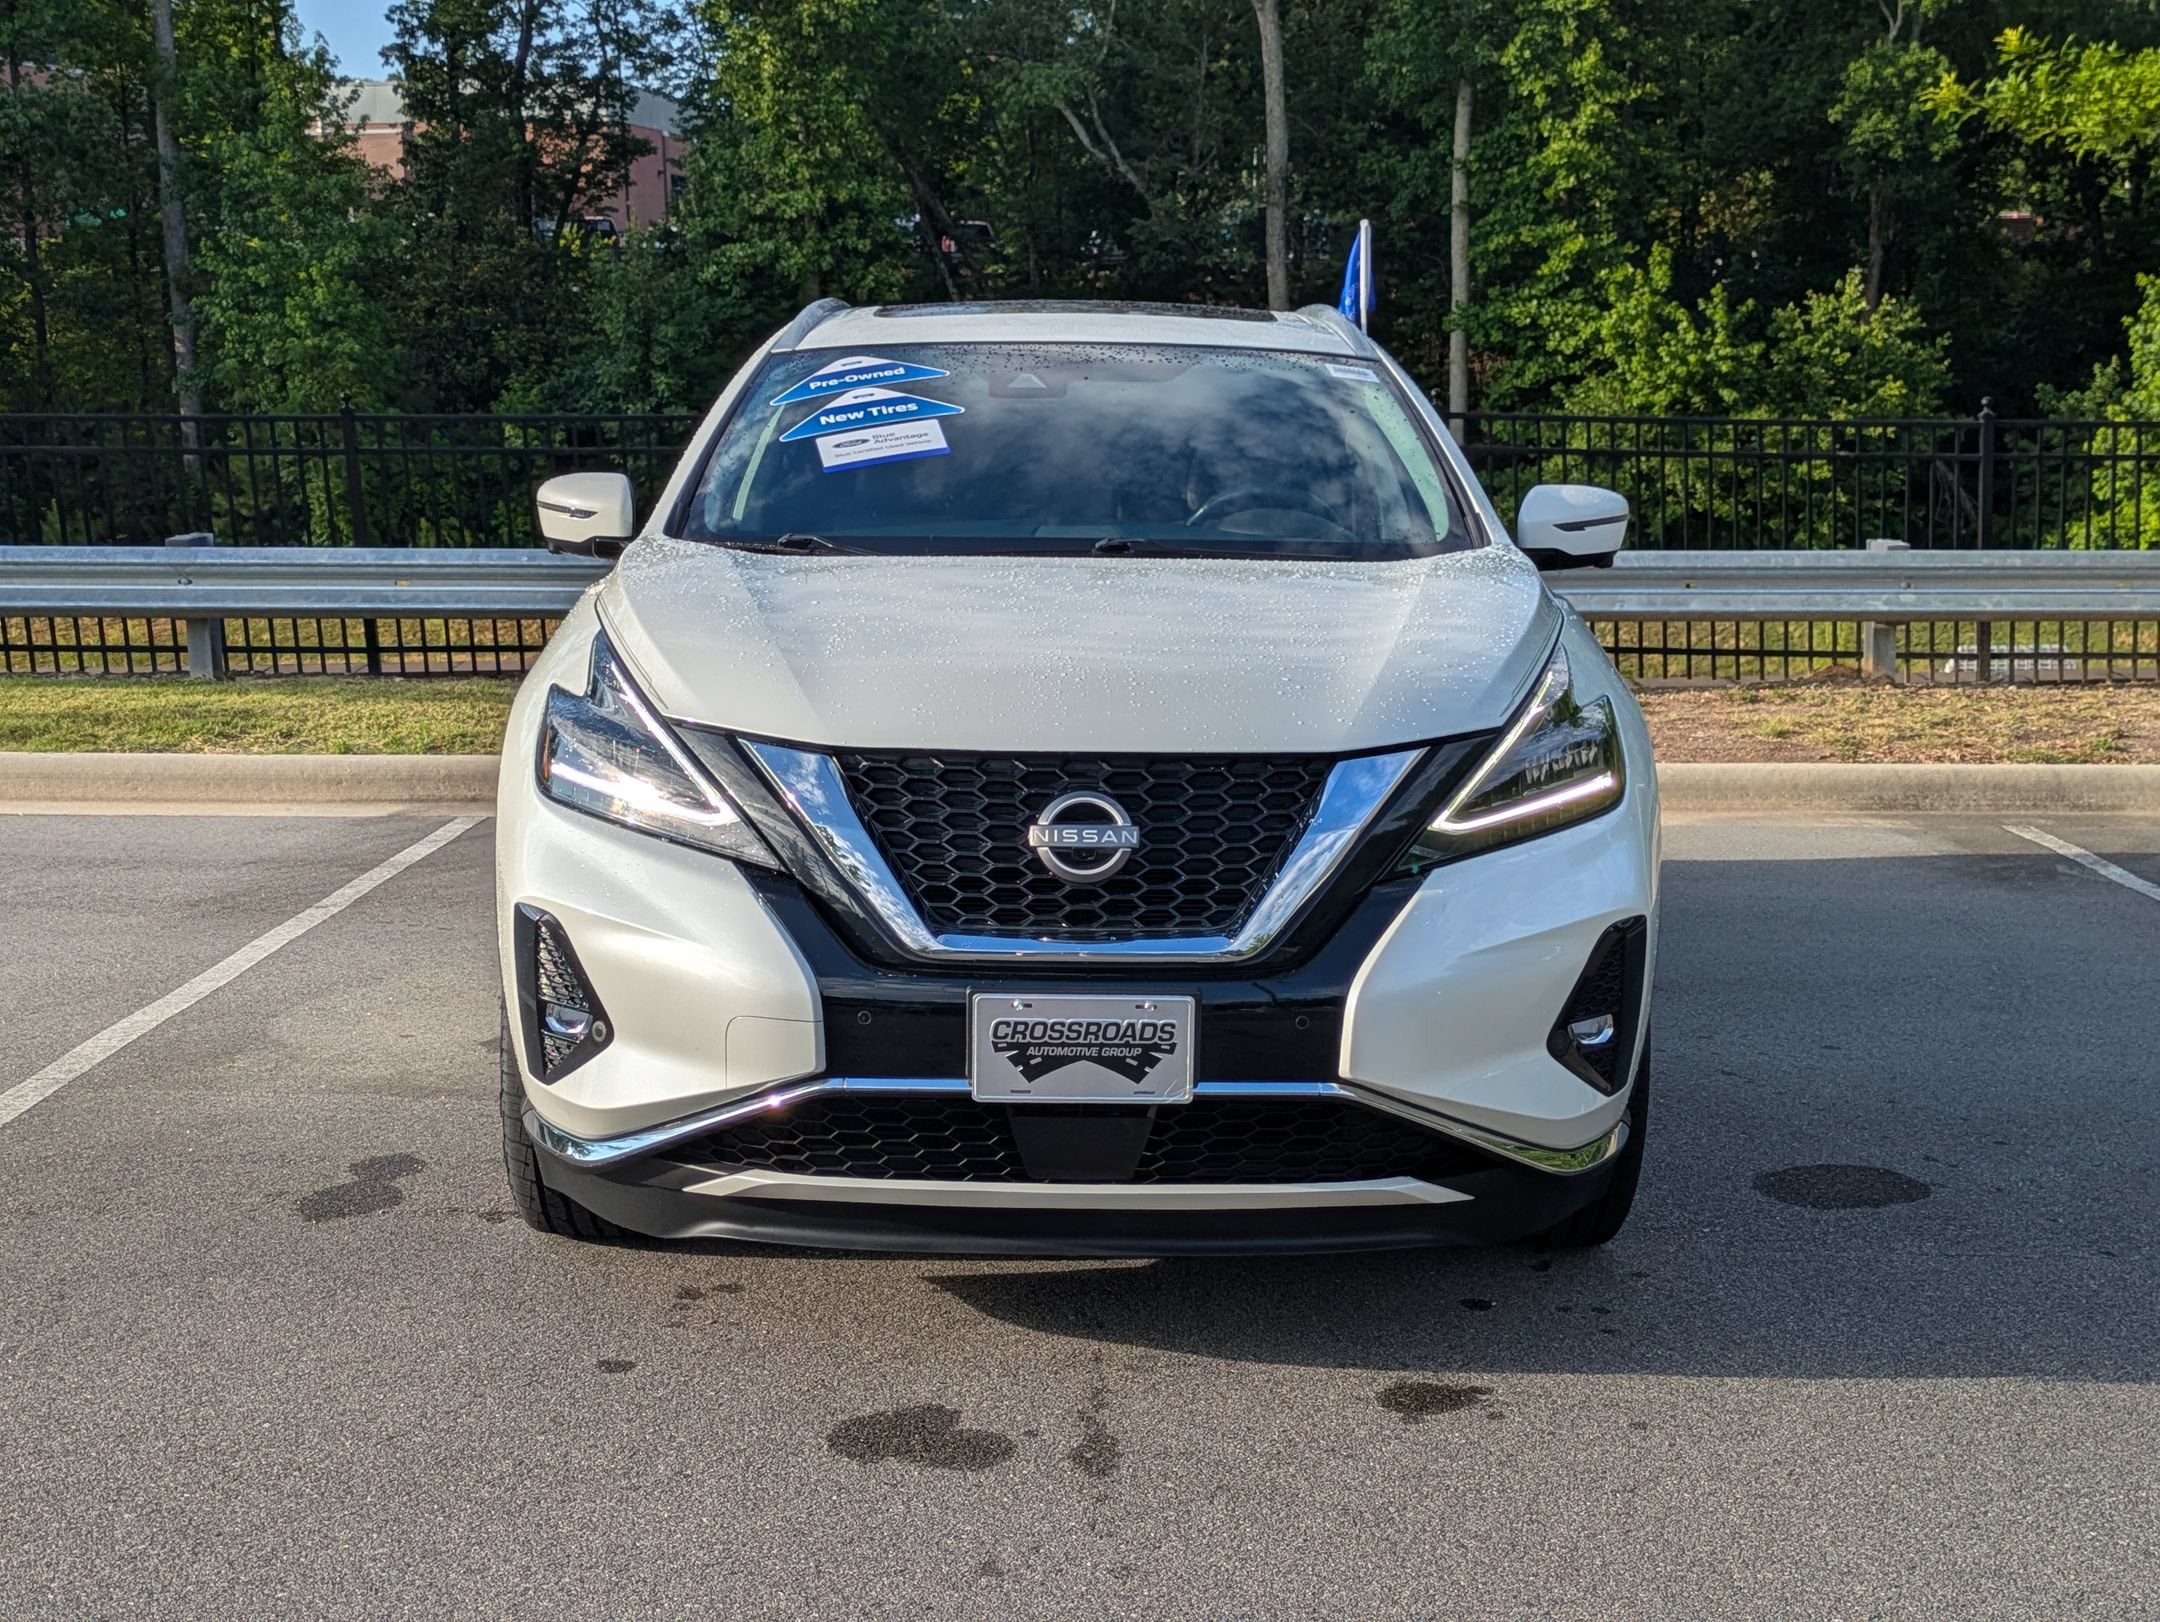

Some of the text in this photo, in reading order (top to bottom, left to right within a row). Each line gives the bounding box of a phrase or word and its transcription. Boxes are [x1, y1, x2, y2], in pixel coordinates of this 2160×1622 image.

[809, 367, 905, 389] Pre-Owned
[820, 403, 918, 425] New Tires
[872, 432, 895, 440] Blue
[873, 432, 929, 444] Advantage
[1033, 829, 1138, 844] NISSAN
[992, 1020, 1176, 1042] CROSSROADS
[1026, 1046, 1142, 1057] AUTOMOTIVE GROUP
